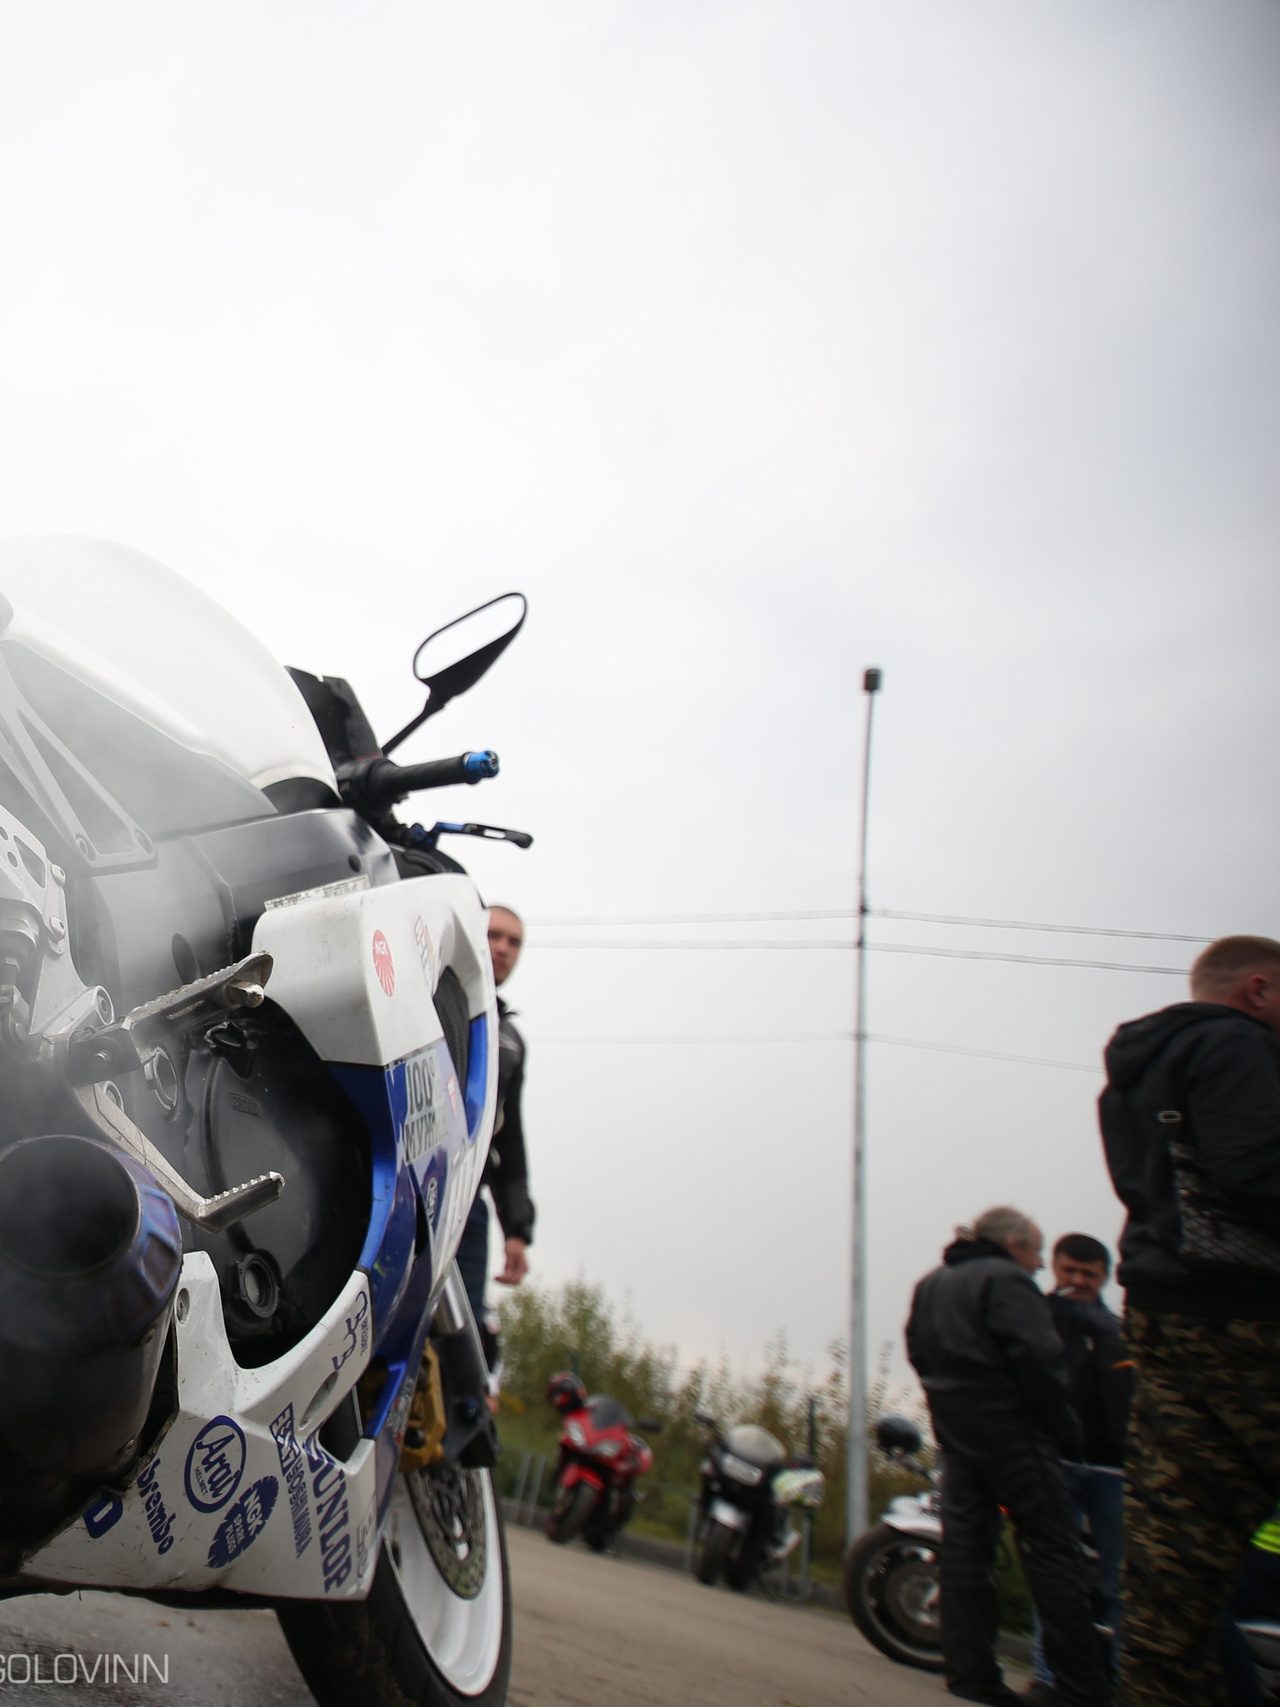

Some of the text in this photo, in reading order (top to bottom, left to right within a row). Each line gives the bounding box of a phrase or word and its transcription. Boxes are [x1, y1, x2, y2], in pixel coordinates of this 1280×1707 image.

[194, 1467, 209, 1496] HELMET
[196, 1433, 241, 1498] Arai
[137, 1458, 176, 1555] brembo
[244, 1489, 263, 1536] NGK
